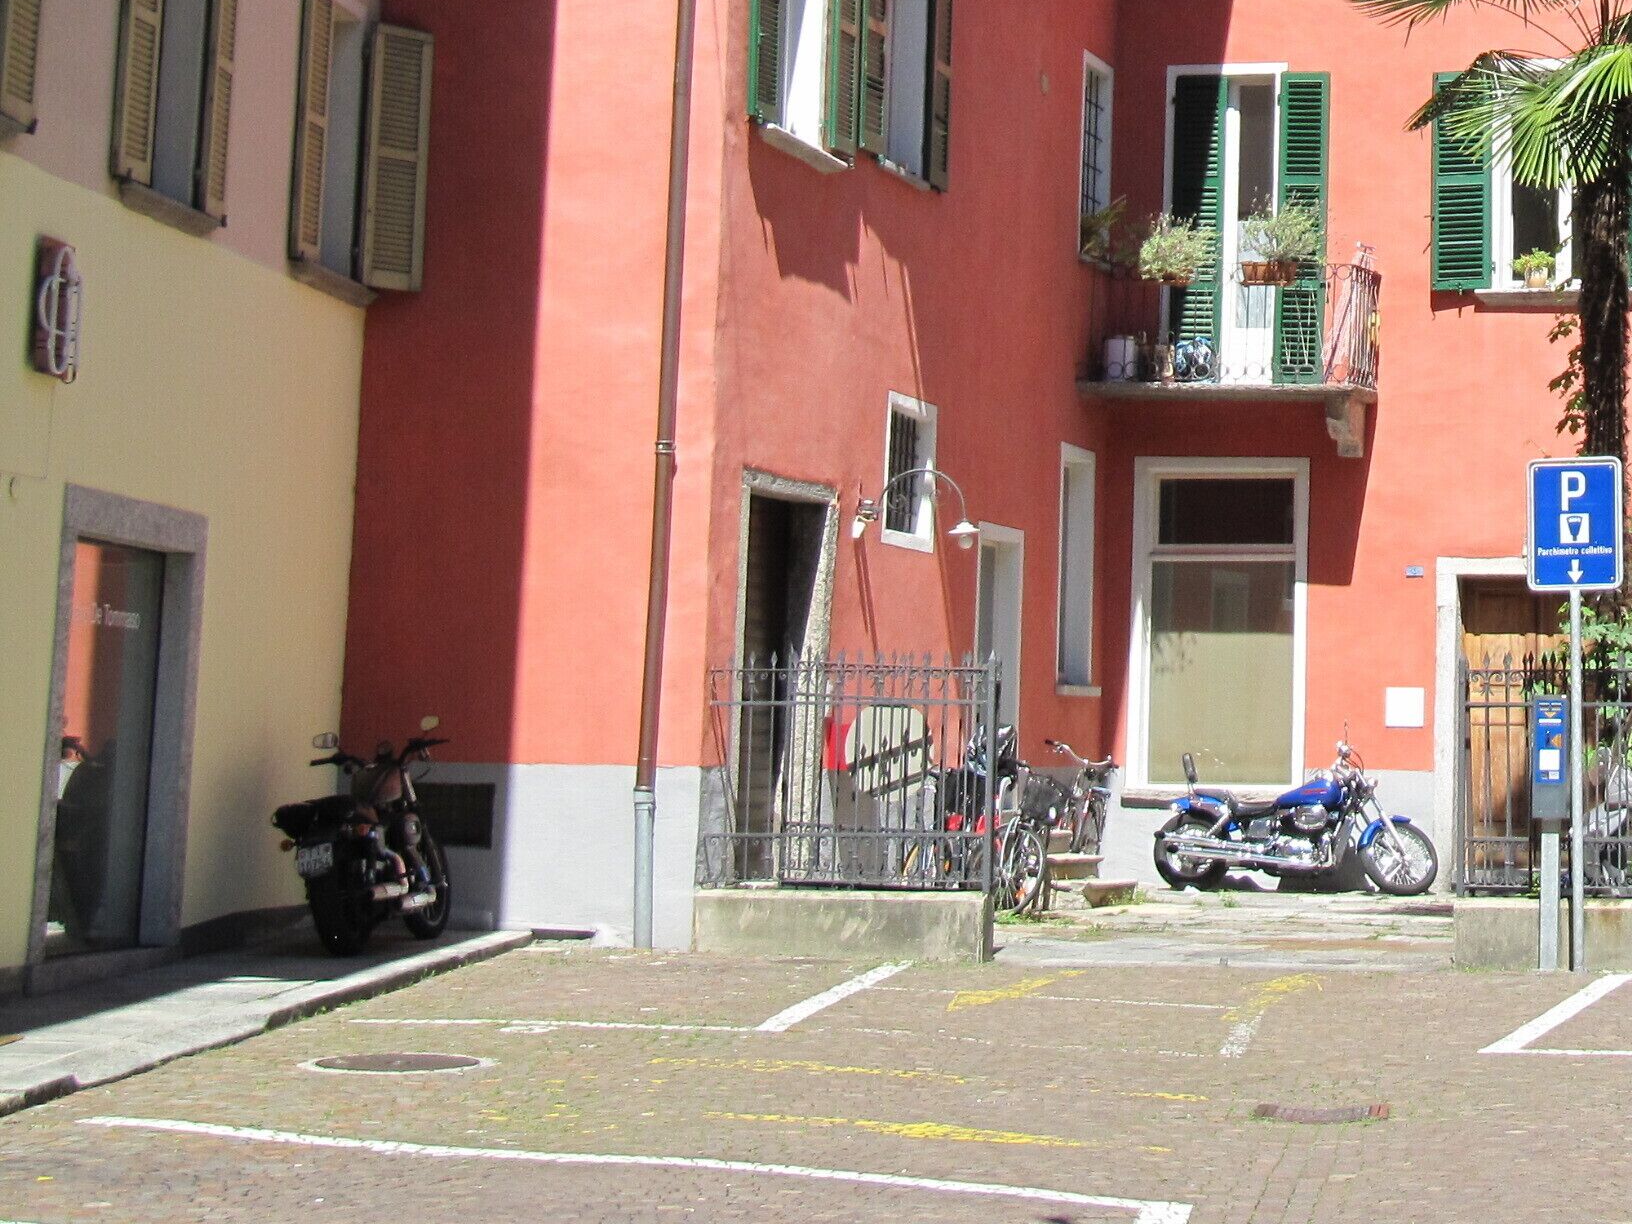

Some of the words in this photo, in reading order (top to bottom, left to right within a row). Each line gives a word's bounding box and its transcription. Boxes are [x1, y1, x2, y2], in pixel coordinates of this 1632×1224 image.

[1560, 470, 1586, 512] P
[1537, 547, 1579, 557] Parchimetro
[1581, 545, 1613, 556] collettivo
